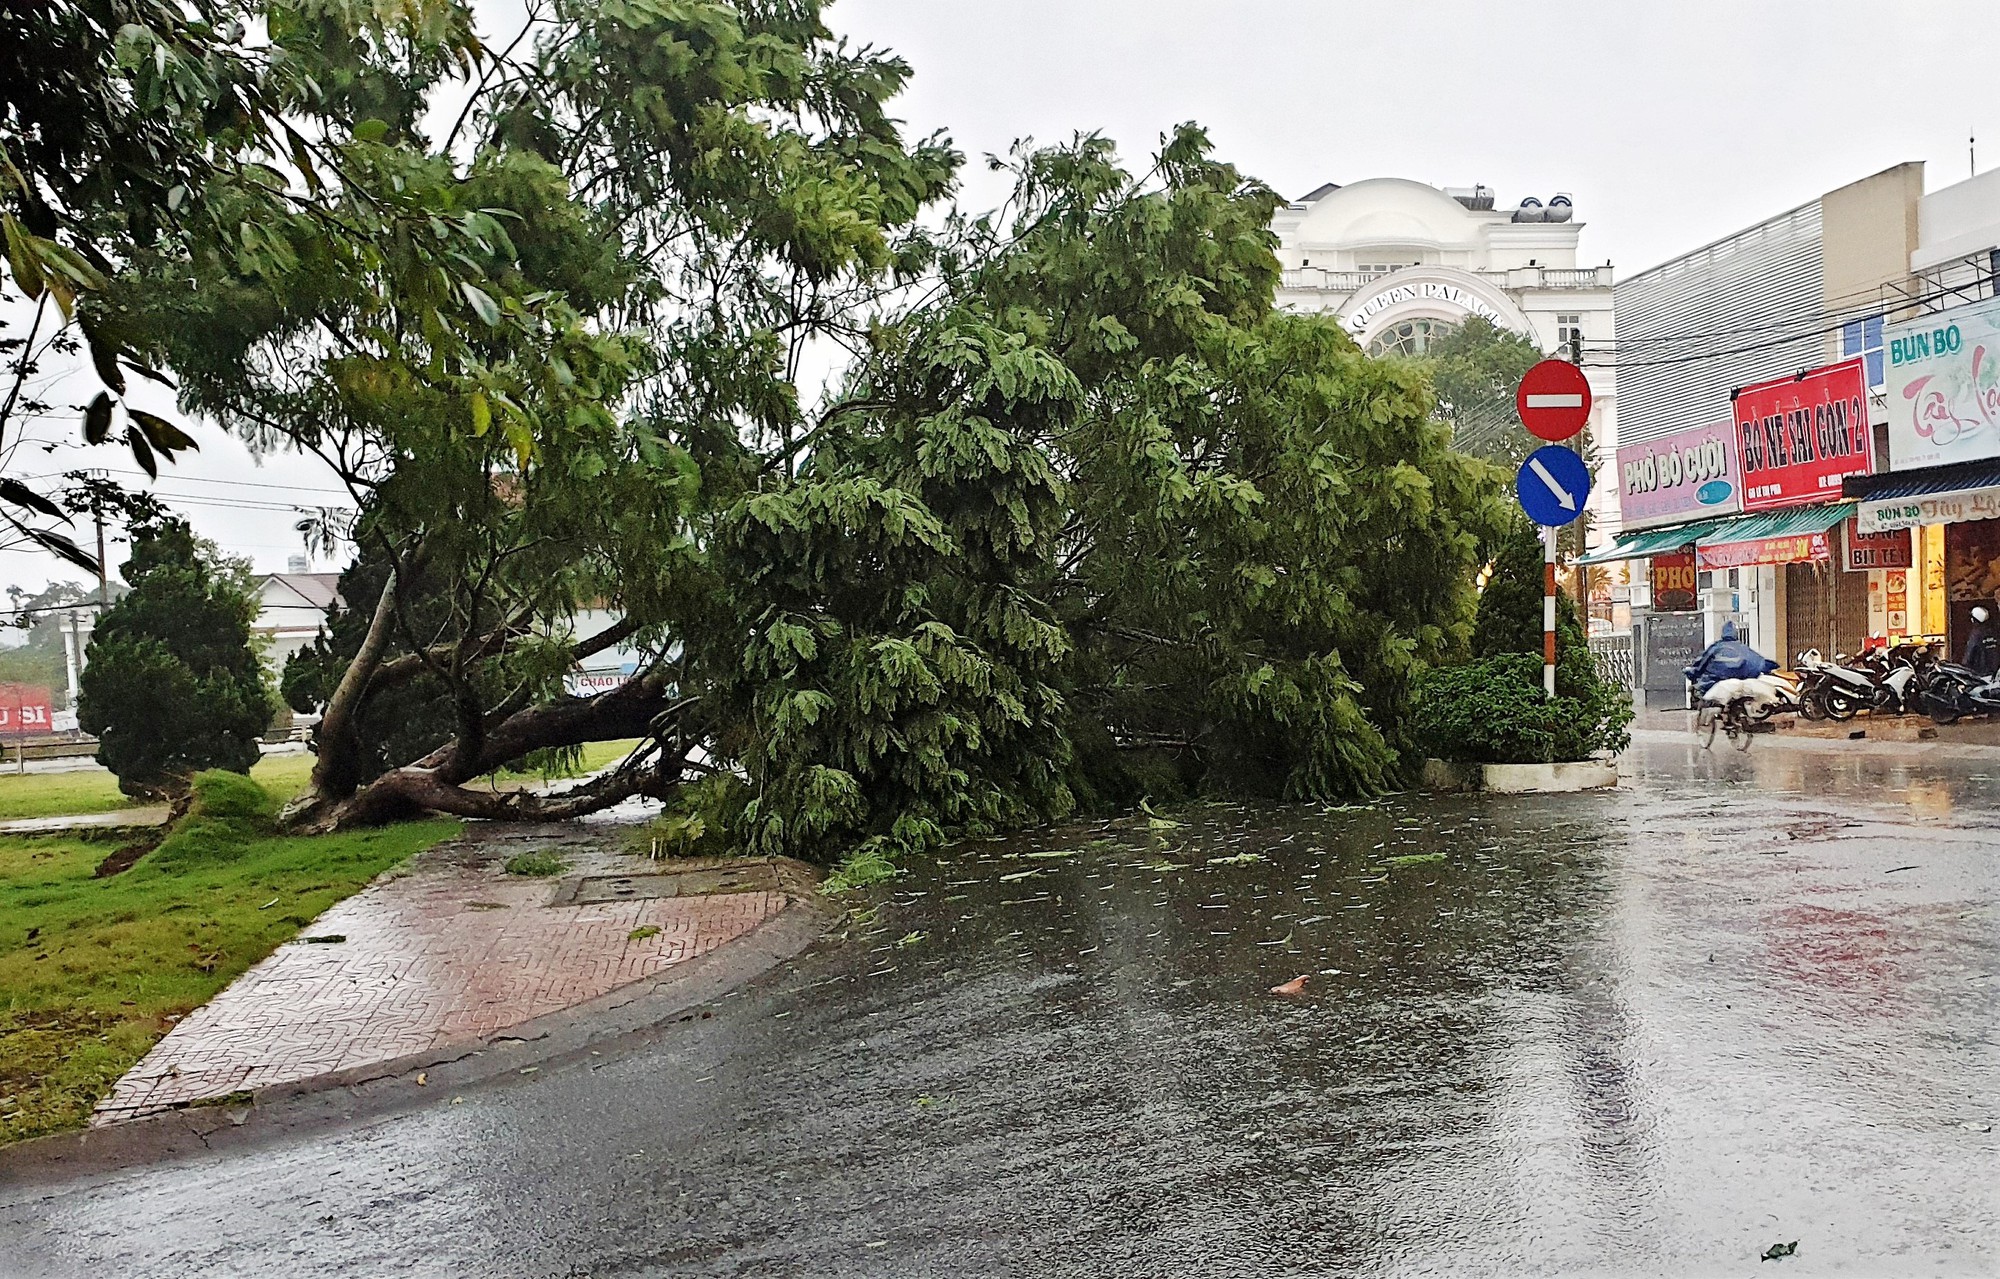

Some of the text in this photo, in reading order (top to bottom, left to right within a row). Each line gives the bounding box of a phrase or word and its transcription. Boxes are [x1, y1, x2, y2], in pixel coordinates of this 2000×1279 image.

[1346, 283, 1416, 331] QUEEN
[1741, 405, 1763, 474] BÒ
[1852, 394, 1864, 454] 2
[1623, 446, 1658, 495] PHỞ
[1658, 442, 1684, 488] BÒ
[1655, 556, 1695, 590] PHỞ
